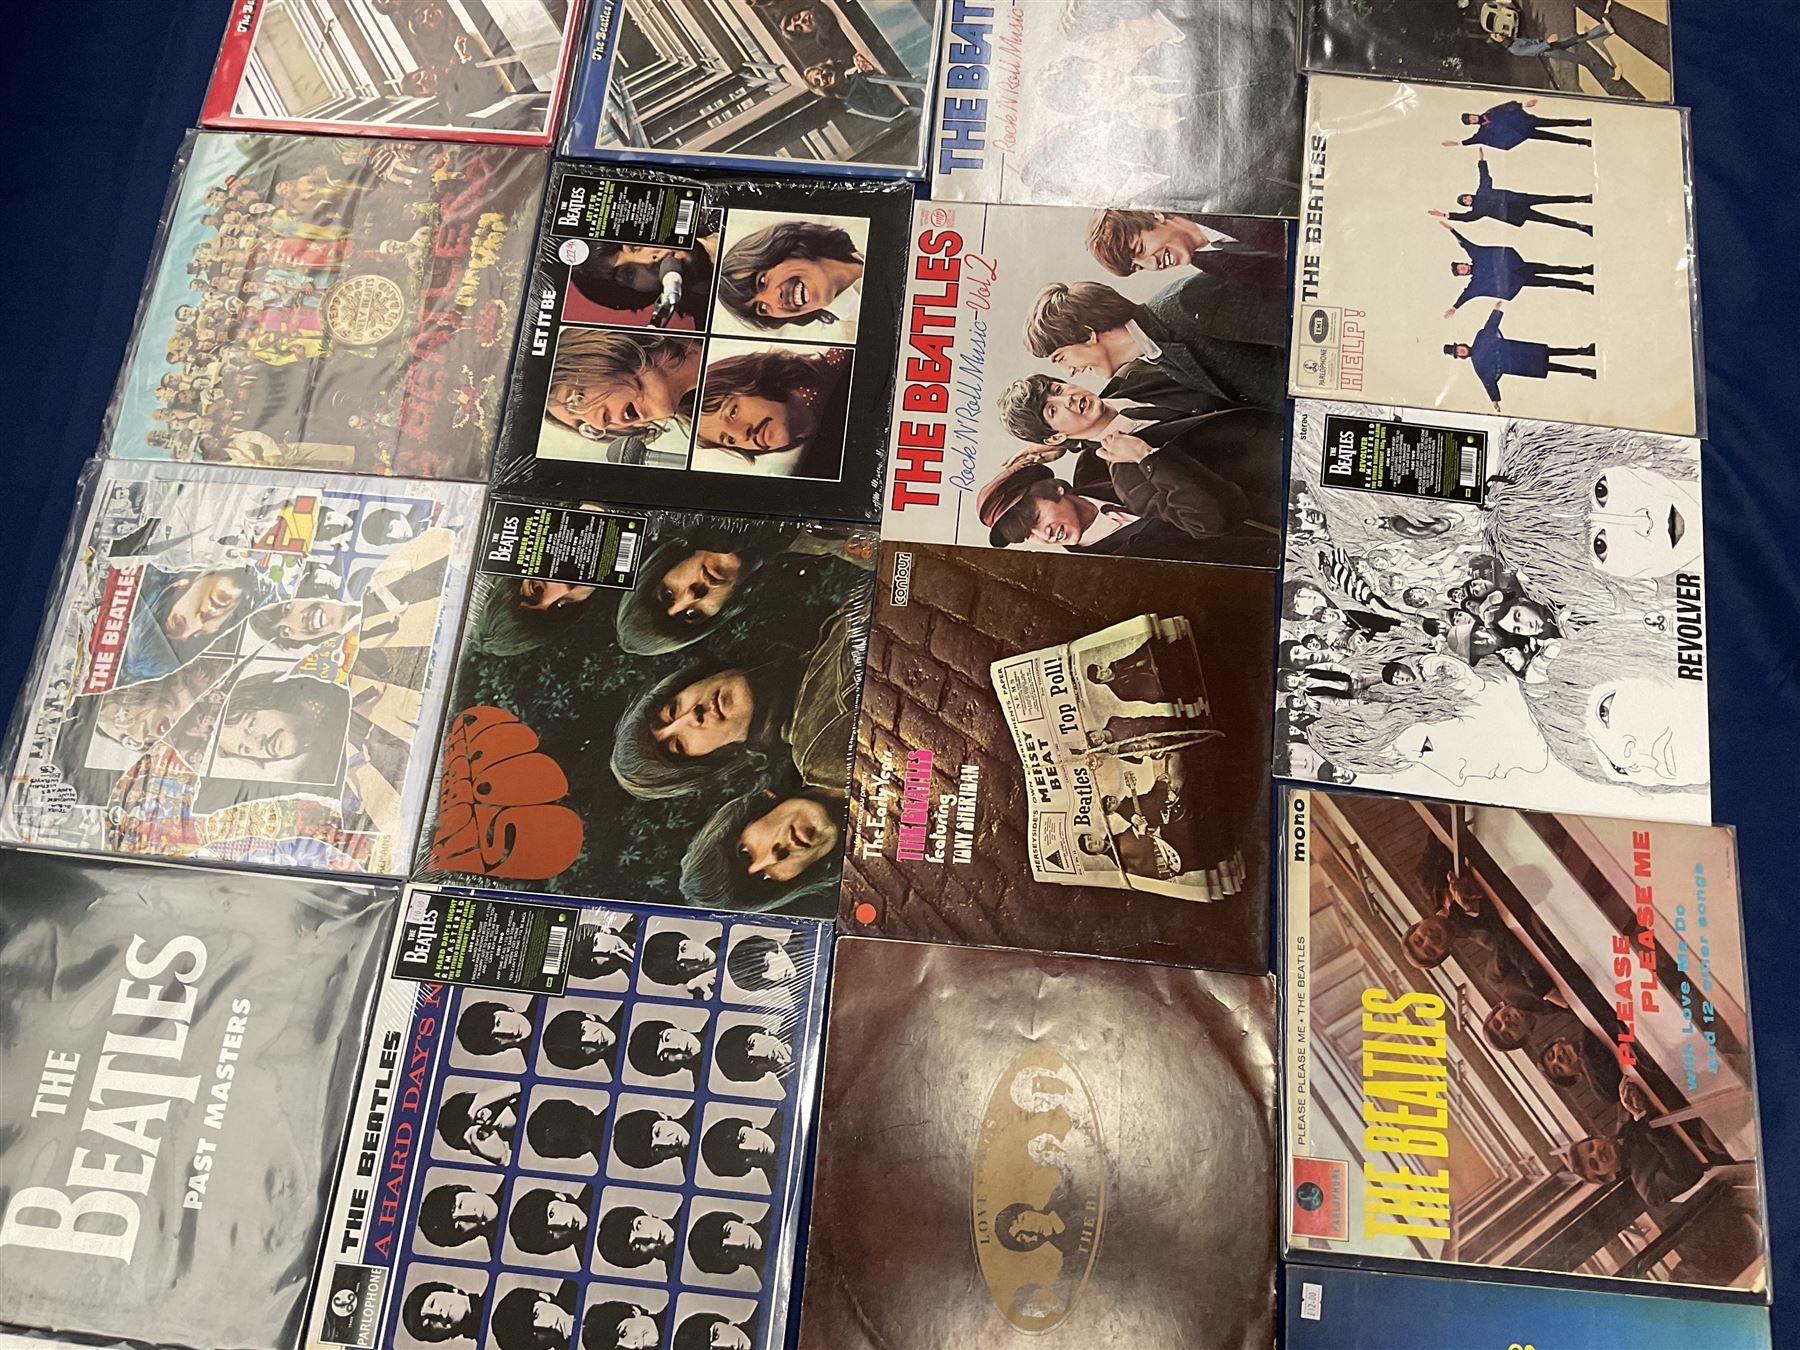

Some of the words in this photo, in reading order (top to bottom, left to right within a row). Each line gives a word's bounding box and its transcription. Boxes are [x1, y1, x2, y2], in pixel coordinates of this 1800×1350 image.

[596, 6, 612, 40] Beatles
[998, 8, 1024, 59] Music
[592, 42, 604, 60] The
[1001, 62, 1020, 91] Roll
[940, 98, 988, 174] THE
[992, 114, 1017, 154] Rock
[557, 186, 589, 226] BEATLES
[588, 180, 605, 236] REMASTERED
[1304, 135, 1326, 244] BEATLES
[963, 253, 996, 280] 2
[1302, 256, 1321, 302] THE
[537, 311, 552, 327] IT
[540, 290, 556, 309] BE
[966, 280, 991, 311] Vol
[532, 328, 549, 356] LET
[902, 229, 964, 414] BEATLES
[958, 320, 988, 383] Music
[1318, 348, 1328, 386] PARLOPHONE
[1340, 308, 1366, 392] HELP!
[956, 383, 982, 421] Roll
[1300, 414, 1309, 440] stereo
[892, 421, 948, 511] THE
[949, 441, 978, 493] Rock
[1328, 429, 1357, 475] BEATLES
[1358, 436, 1368, 472] REVOLVER
[1364, 423, 1374, 487] REMASTERED
[488, 514, 522, 562] BEATLES
[491, 532, 499, 542] THE
[516, 536, 528, 564] RUBBER
[523, 516, 533, 534] SOUL
[521, 508, 540, 573] REMASTERED
[895, 554, 911, 606] contour
[99, 564, 140, 646] BEATLES
[1676, 573, 1703, 681] REVOLVER
[88, 651, 116, 690] THE
[997, 667, 1008, 695] PAPER
[1044, 657, 1068, 697] Poll!
[1058, 704, 1079, 735] Top
[870, 750, 894, 788] Years
[900, 750, 934, 825] BEATLES
[1022, 730, 1051, 803] MERSEY
[1037, 739, 1062, 790] BEAT
[866, 787, 896, 827] Early
[955, 765, 980, 831] SHERIDAN
[1028, 781, 1038, 804] OWN
[1073, 768, 1093, 827] Beatles
[862, 829, 884, 860] The
[896, 825, 926, 862] THE
[926, 794, 958, 864] featuring
[953, 832, 974, 865] TONY
[1032, 810, 1042, 872] MERSEYSIDE'S
[1293, 798, 1306, 862] mono
[1632, 830, 1651, 878] ME
[446, 898, 457, 922] NIGHT
[1674, 904, 1686, 932] Do
[1694, 863, 1708, 928] songs
[402, 907, 442, 964] BEATLES
[407, 928, 416, 941] THE
[435, 948, 446, 969] HARD
[440, 923, 451, 946] DAY'S
[441, 900, 464, 978] REMASTERED
[1634, 885, 1660, 1013] PLEASE
[1676, 938, 1689, 972] Me
[1297, 936, 1306, 988] BEATLES
[1698, 936, 1712, 992] other
[1297, 993, 1306, 1015] THE
[1612, 935, 1637, 1065] PLEASE
[1680, 981, 1694, 1034] Love
[1702, 1000, 1714, 1022] 12
[1297, 1026, 1306, 1043] ME
[31, 1050, 80, 1118] THE
[402, 1017, 435, 1113] DAY'S
[1297, 1047, 1306, 1093] PLEASE
[1361, 988, 1450, 1158] BEATLES
[0, 933, 207, 1265] BEATLES
[183, 1138, 217, 1210] PAST
[203, 998, 250, 1129] MASTERS
[1297, 1098, 1306, 1145] PLEASE
[340, 1188, 369, 1254] THE
[356, 1030, 401, 1177] BEATLES
[379, 1121, 412, 1226] HARD
[976, 1194, 990, 1244] LOVE
[1331, 1167, 1340, 1232] PARLOPHONE
[1363, 1162, 1450, 1240] THE
[374, 1234, 389, 1257] A
[1079, 1216, 1094, 1254] THE
[357, 1267, 383, 1346] PARLOPHONE
